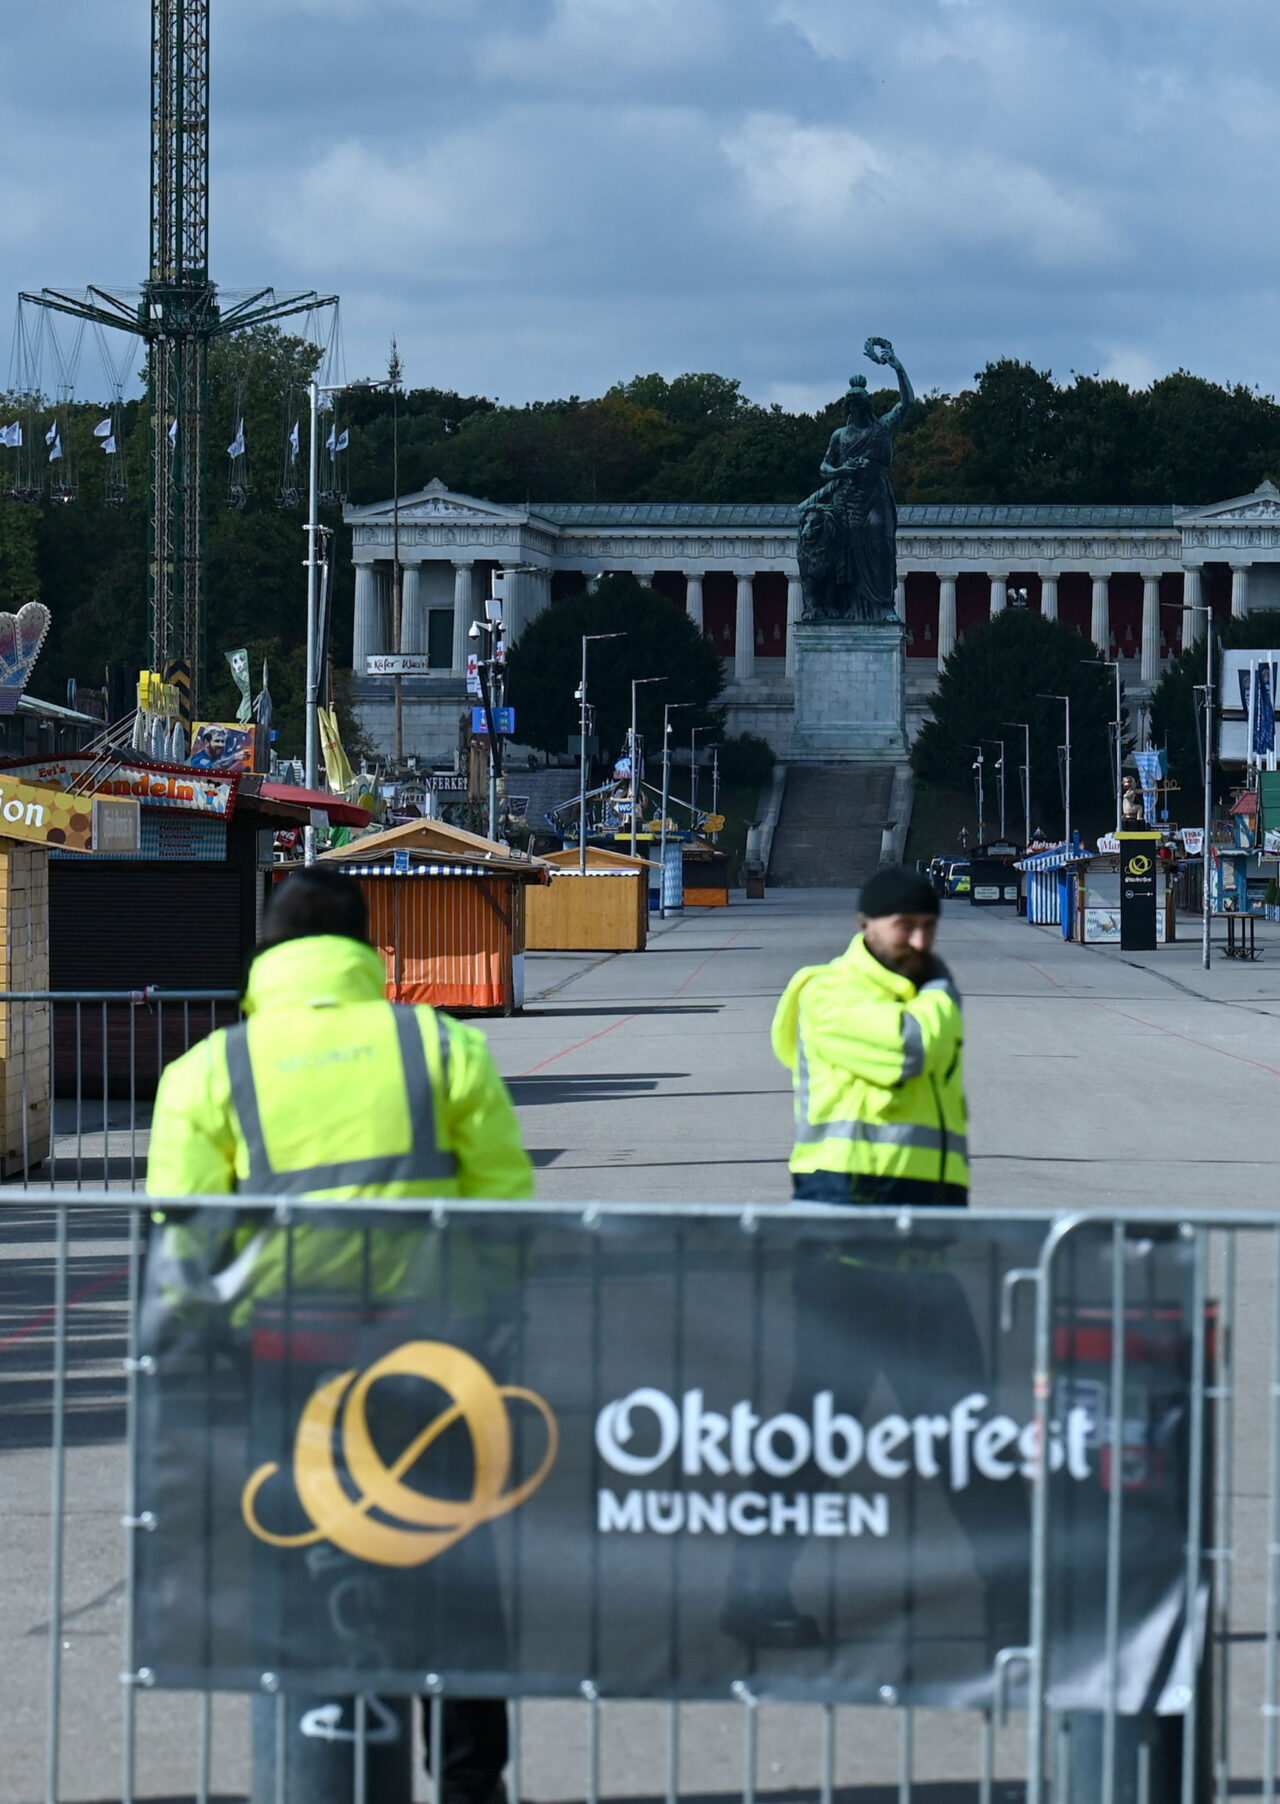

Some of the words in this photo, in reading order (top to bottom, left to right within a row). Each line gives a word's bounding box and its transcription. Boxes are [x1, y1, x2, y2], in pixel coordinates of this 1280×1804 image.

[71, 772, 194, 801] Mandeln
[619, 802, 632, 812] WC
[595, 1386, 1095, 1493] Oktoberfest
[598, 1489, 890, 1538] MÜNCHEN
